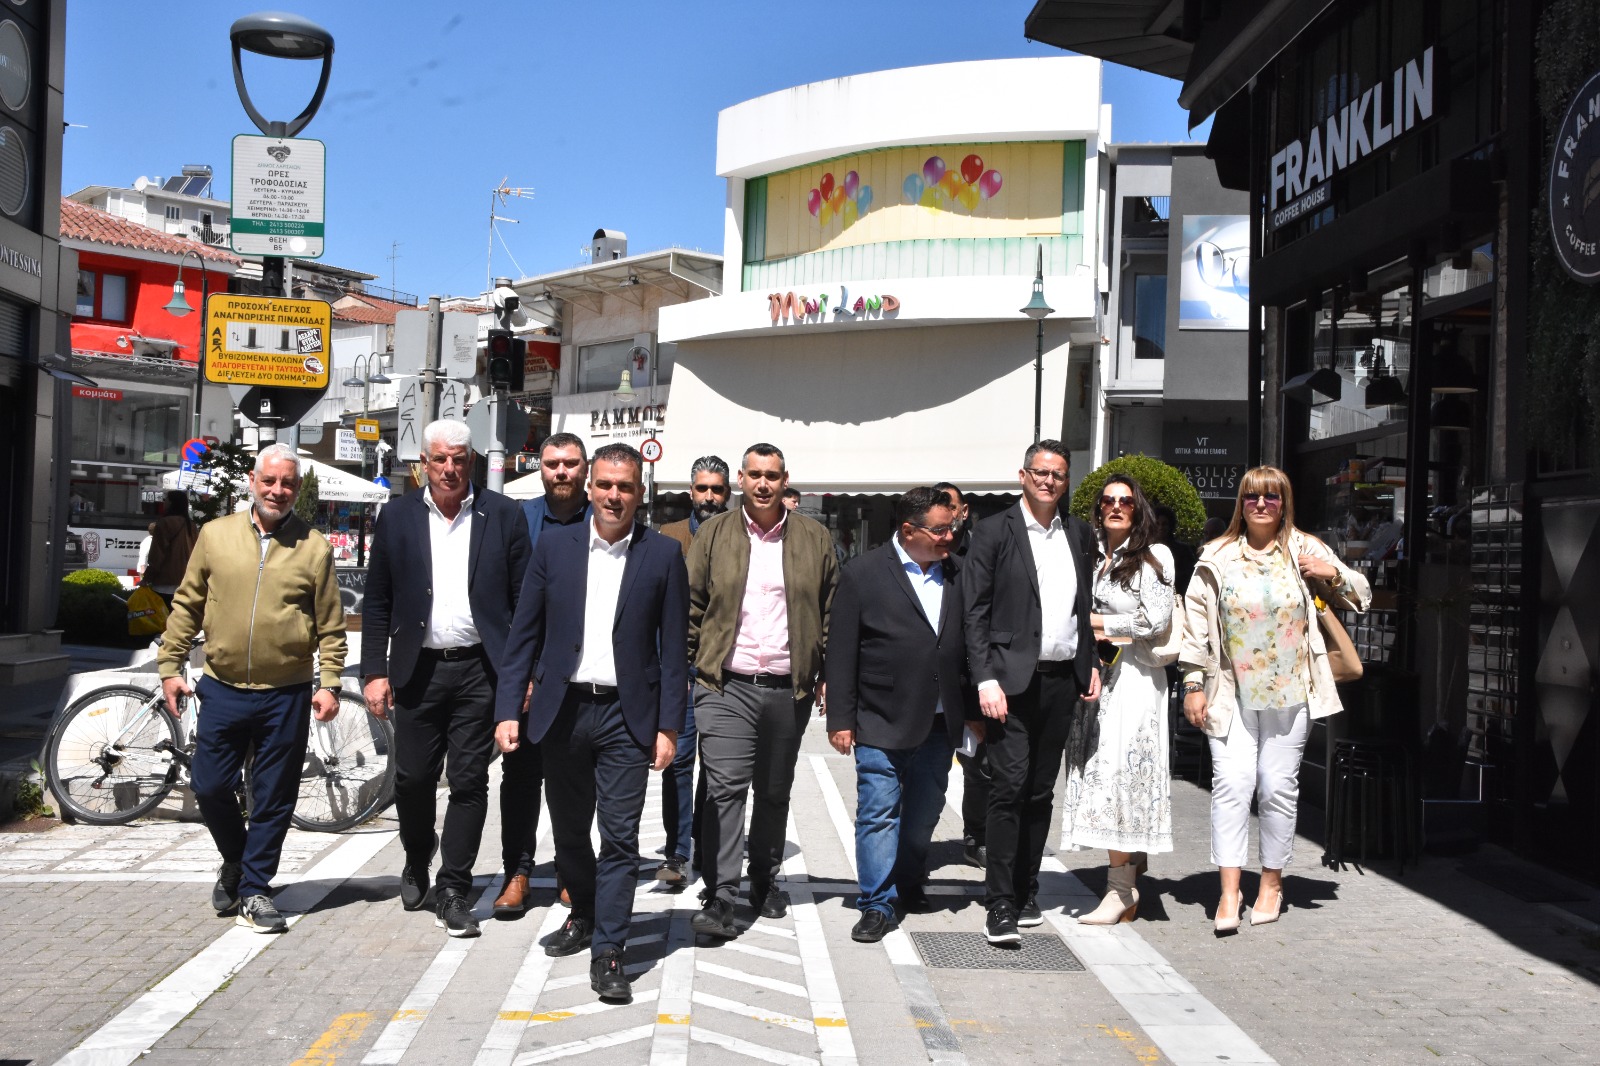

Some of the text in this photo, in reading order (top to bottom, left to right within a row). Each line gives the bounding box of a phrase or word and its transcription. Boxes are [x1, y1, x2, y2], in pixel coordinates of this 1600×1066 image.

[1271, 46, 1434, 212] FRANKLIN
[250, 178, 308, 188] ΤΡΟΦΟΔΟΣΙΑΣ
[1274, 187, 1325, 226] COFFEE HOUSE
[1566, 224, 1596, 256] COFFEE
[228, 302, 311, 314] ΠΡΟΣΟΧΗ ΕΛΕΓΧΟΣ
[214, 311, 325, 325] ΑΝΑΓΝΩΡΙΣΗΣ ΠΙΝΑΚΙΔΑΣ
[219, 353, 269, 362] ΒΥΘΙΖΟΜΕΝΑ
[212, 362, 267, 371] ΑΠΑΓΟΡΕΥΕΤΑΙ
[218, 371, 255, 379] ΔΙΕΛΕΥΣΗ
[275, 374, 317, 382] ΟΧΗΜΑΤΩΝ
[80, 390, 116, 398] κομμάτι
[443, 384, 456, 419] ΑΕ
[590, 404, 665, 427] ΡΑΜΜΟΣ
[1197, 437, 1209, 446] VT
[182, 461, 190, 470] P
